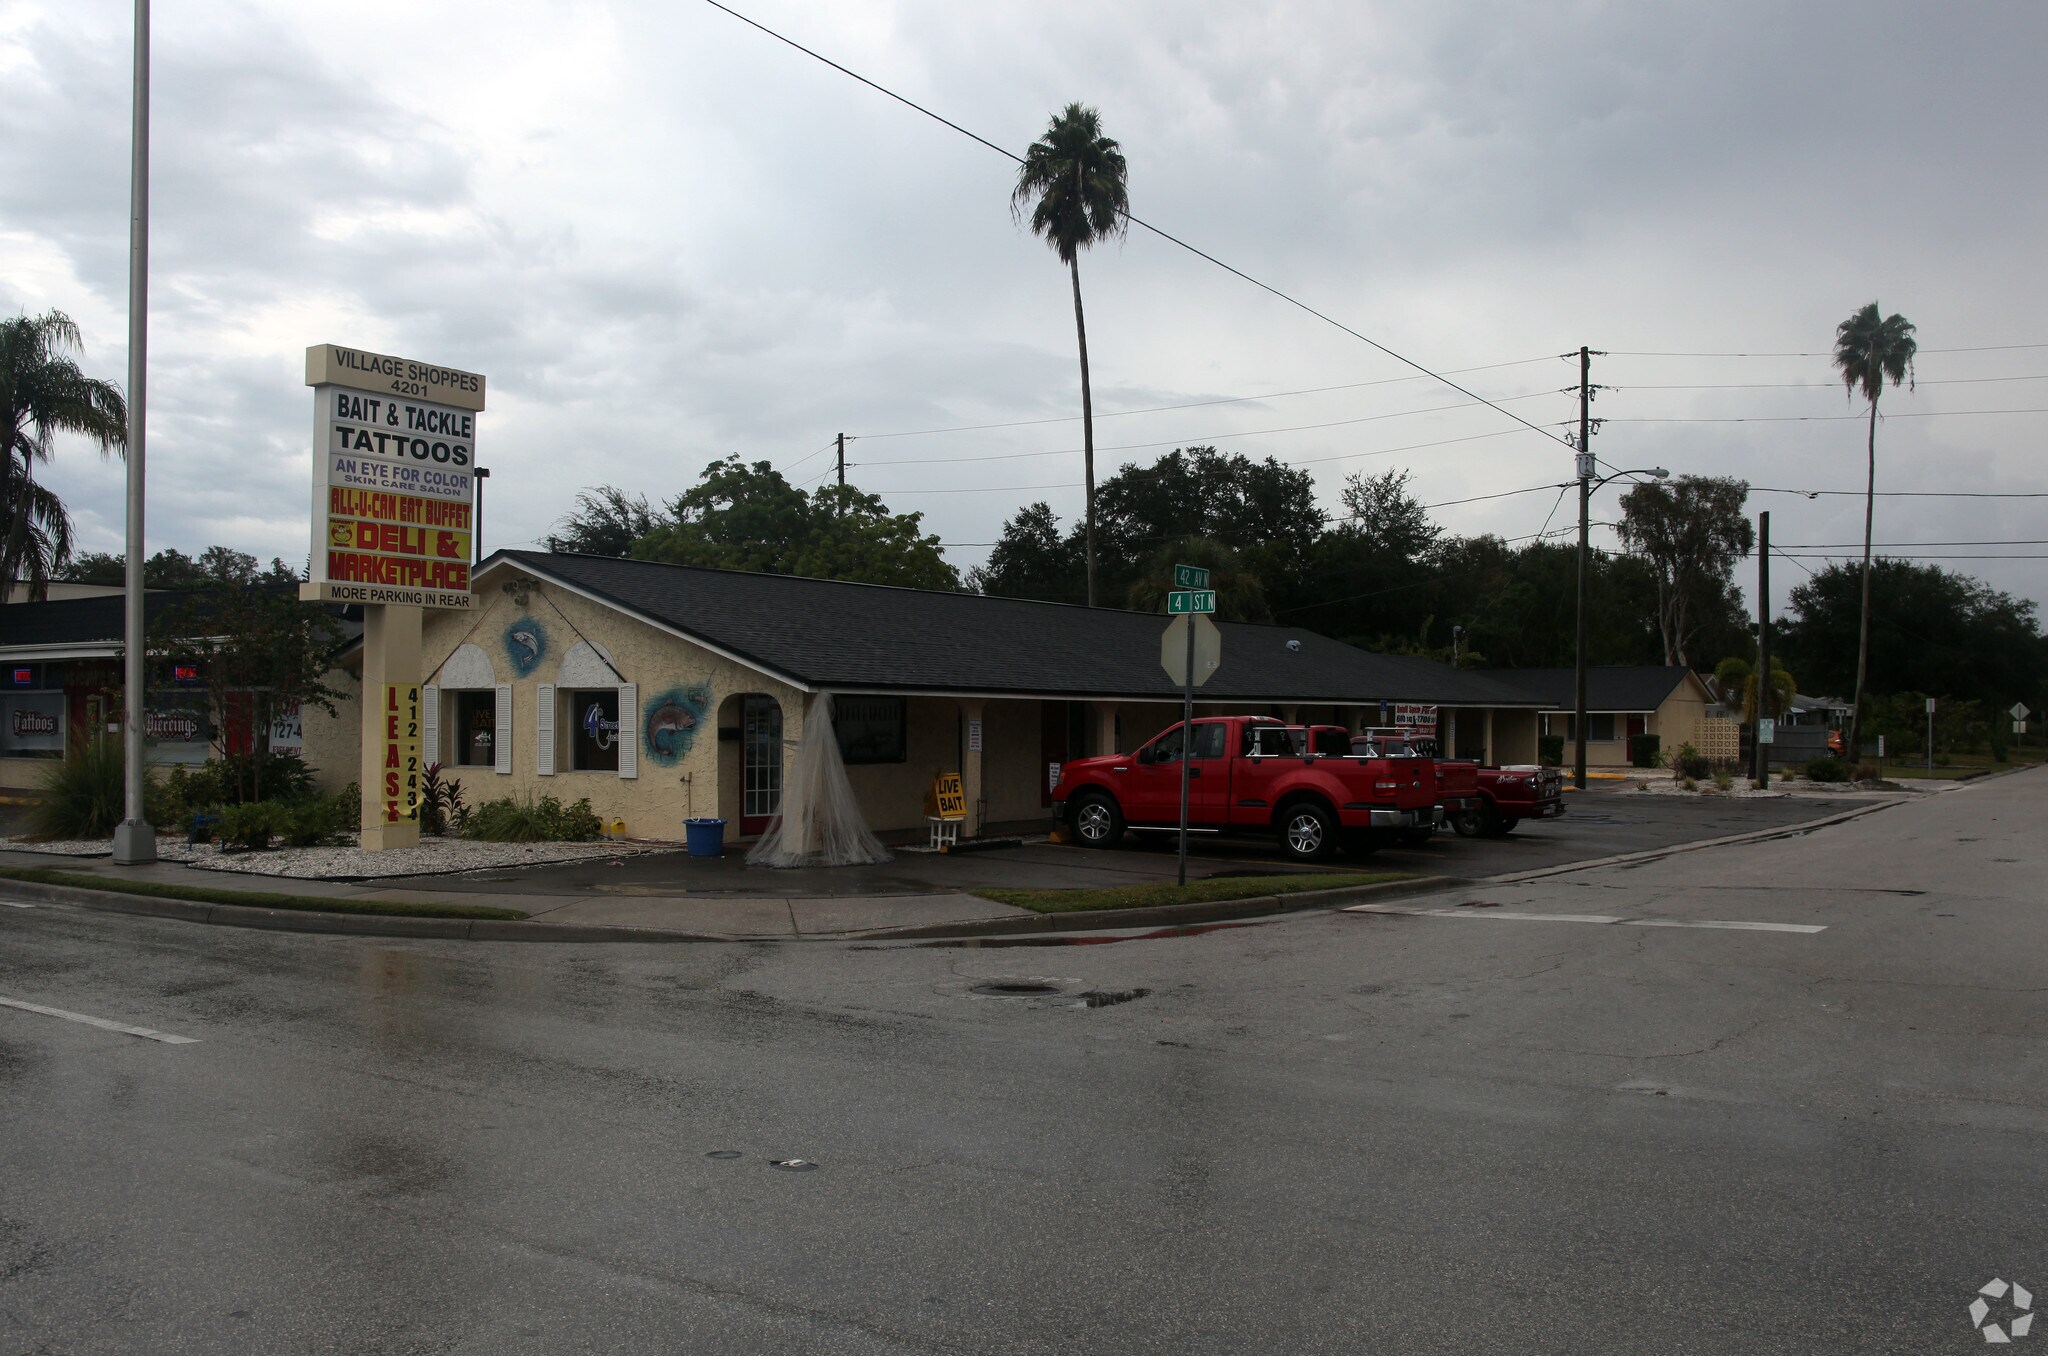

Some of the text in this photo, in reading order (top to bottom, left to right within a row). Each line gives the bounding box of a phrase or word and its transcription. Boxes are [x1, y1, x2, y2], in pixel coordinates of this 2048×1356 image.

[336, 349, 478, 392] VILLAGE SHOPPES
[391, 380, 428, 397] 4201
[338, 394, 471, 438] BAIT & TACKLE
[336, 426, 468, 466] TATTOOS
[335, 459, 468, 489] AN EYE FOR COLOR
[344, 475, 461, 496] SKIN CARE SALON
[400, 497, 422, 523] EAT
[426, 501, 469, 529] BUFFET
[357, 522, 460, 559] DELI &
[328, 551, 467, 591] MARKETPLACE
[1180, 569, 1190, 585] 42
[1194, 571, 1203, 586] AV
[331, 587, 469, 607] MORE PARKING IN REAR
[1175, 594, 1214, 610] 4 ST N
[13, 710, 55, 735] Tattoos
[144, 712, 198, 740] Piercings
[386, 687, 400, 822] LEASE
[939, 779, 958, 794] LIVE
[940, 796, 962, 811] BAIT
